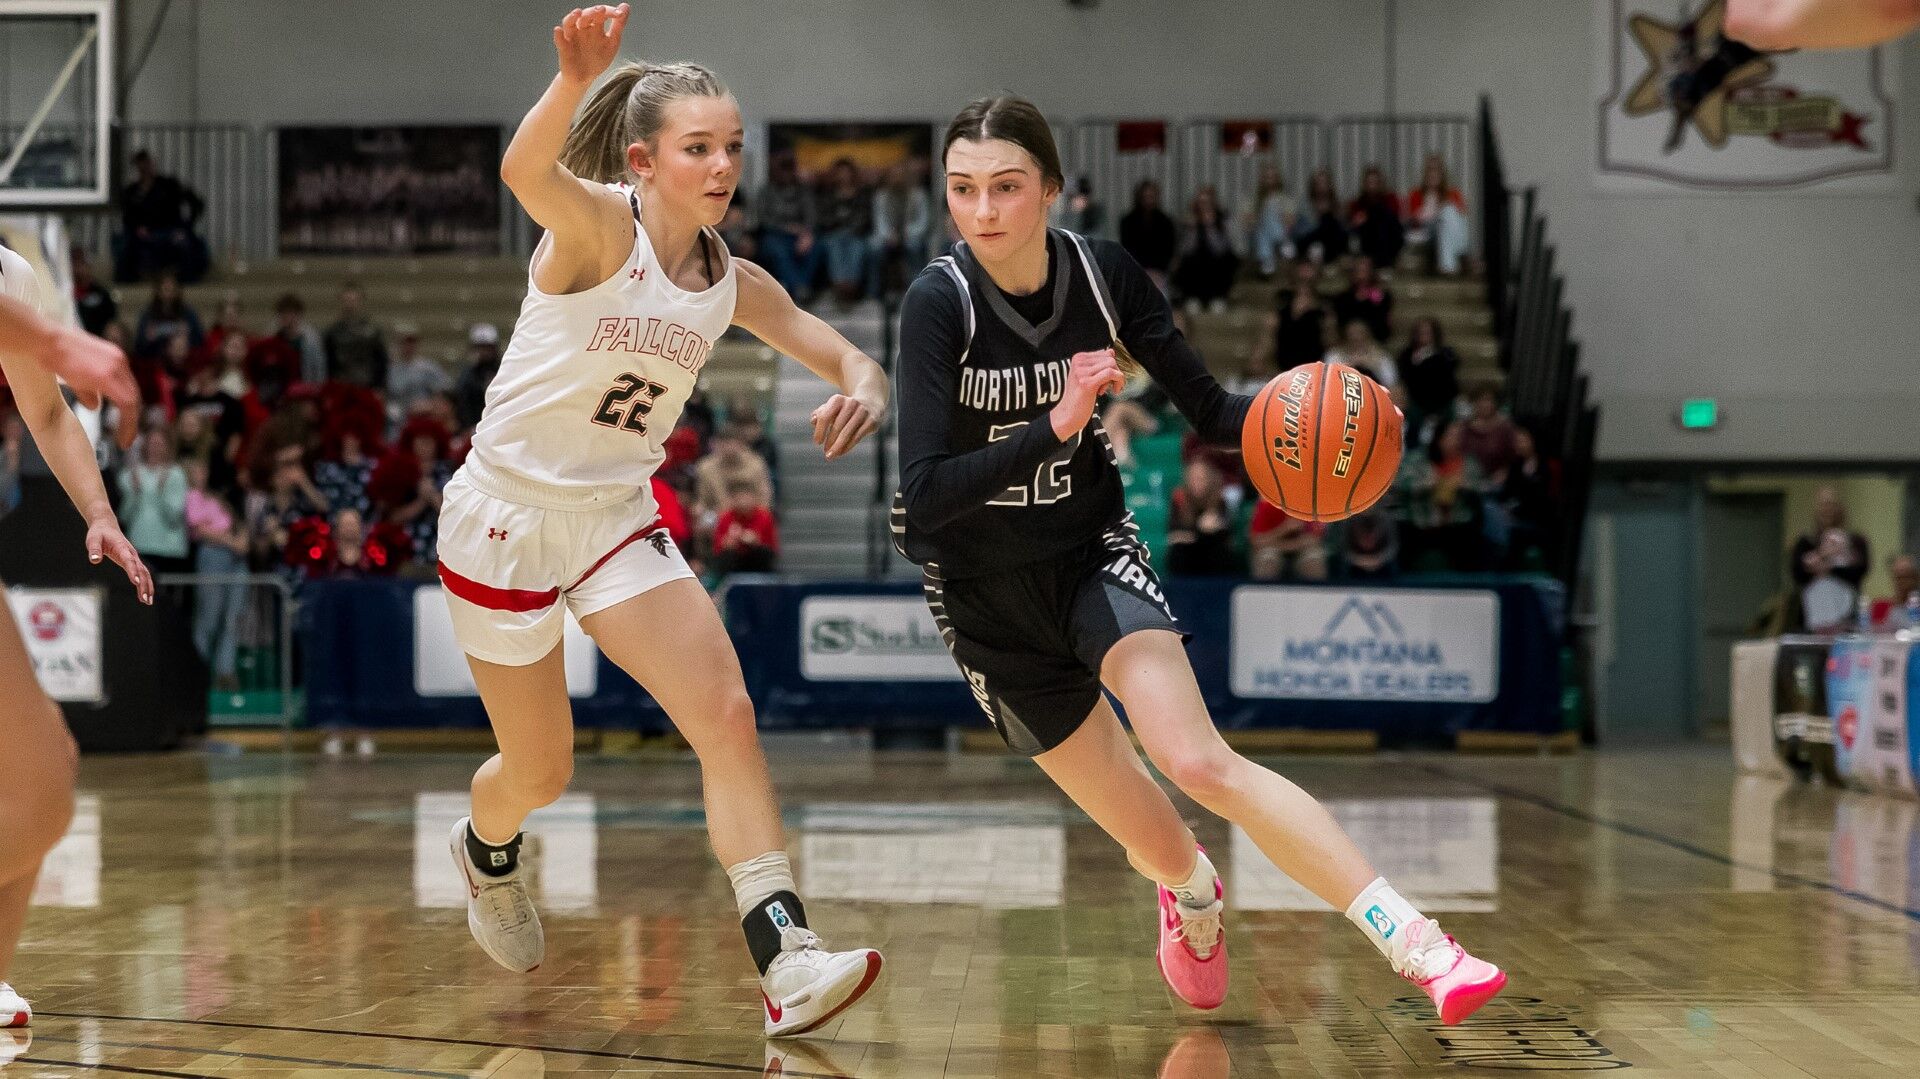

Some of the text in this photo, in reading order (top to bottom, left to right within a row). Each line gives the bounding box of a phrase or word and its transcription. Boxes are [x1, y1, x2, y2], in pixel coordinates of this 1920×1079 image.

[959, 366, 1027, 412] NORTH
[1273, 371, 1313, 472] Baden
[1282, 637, 1443, 666] MONTANA
